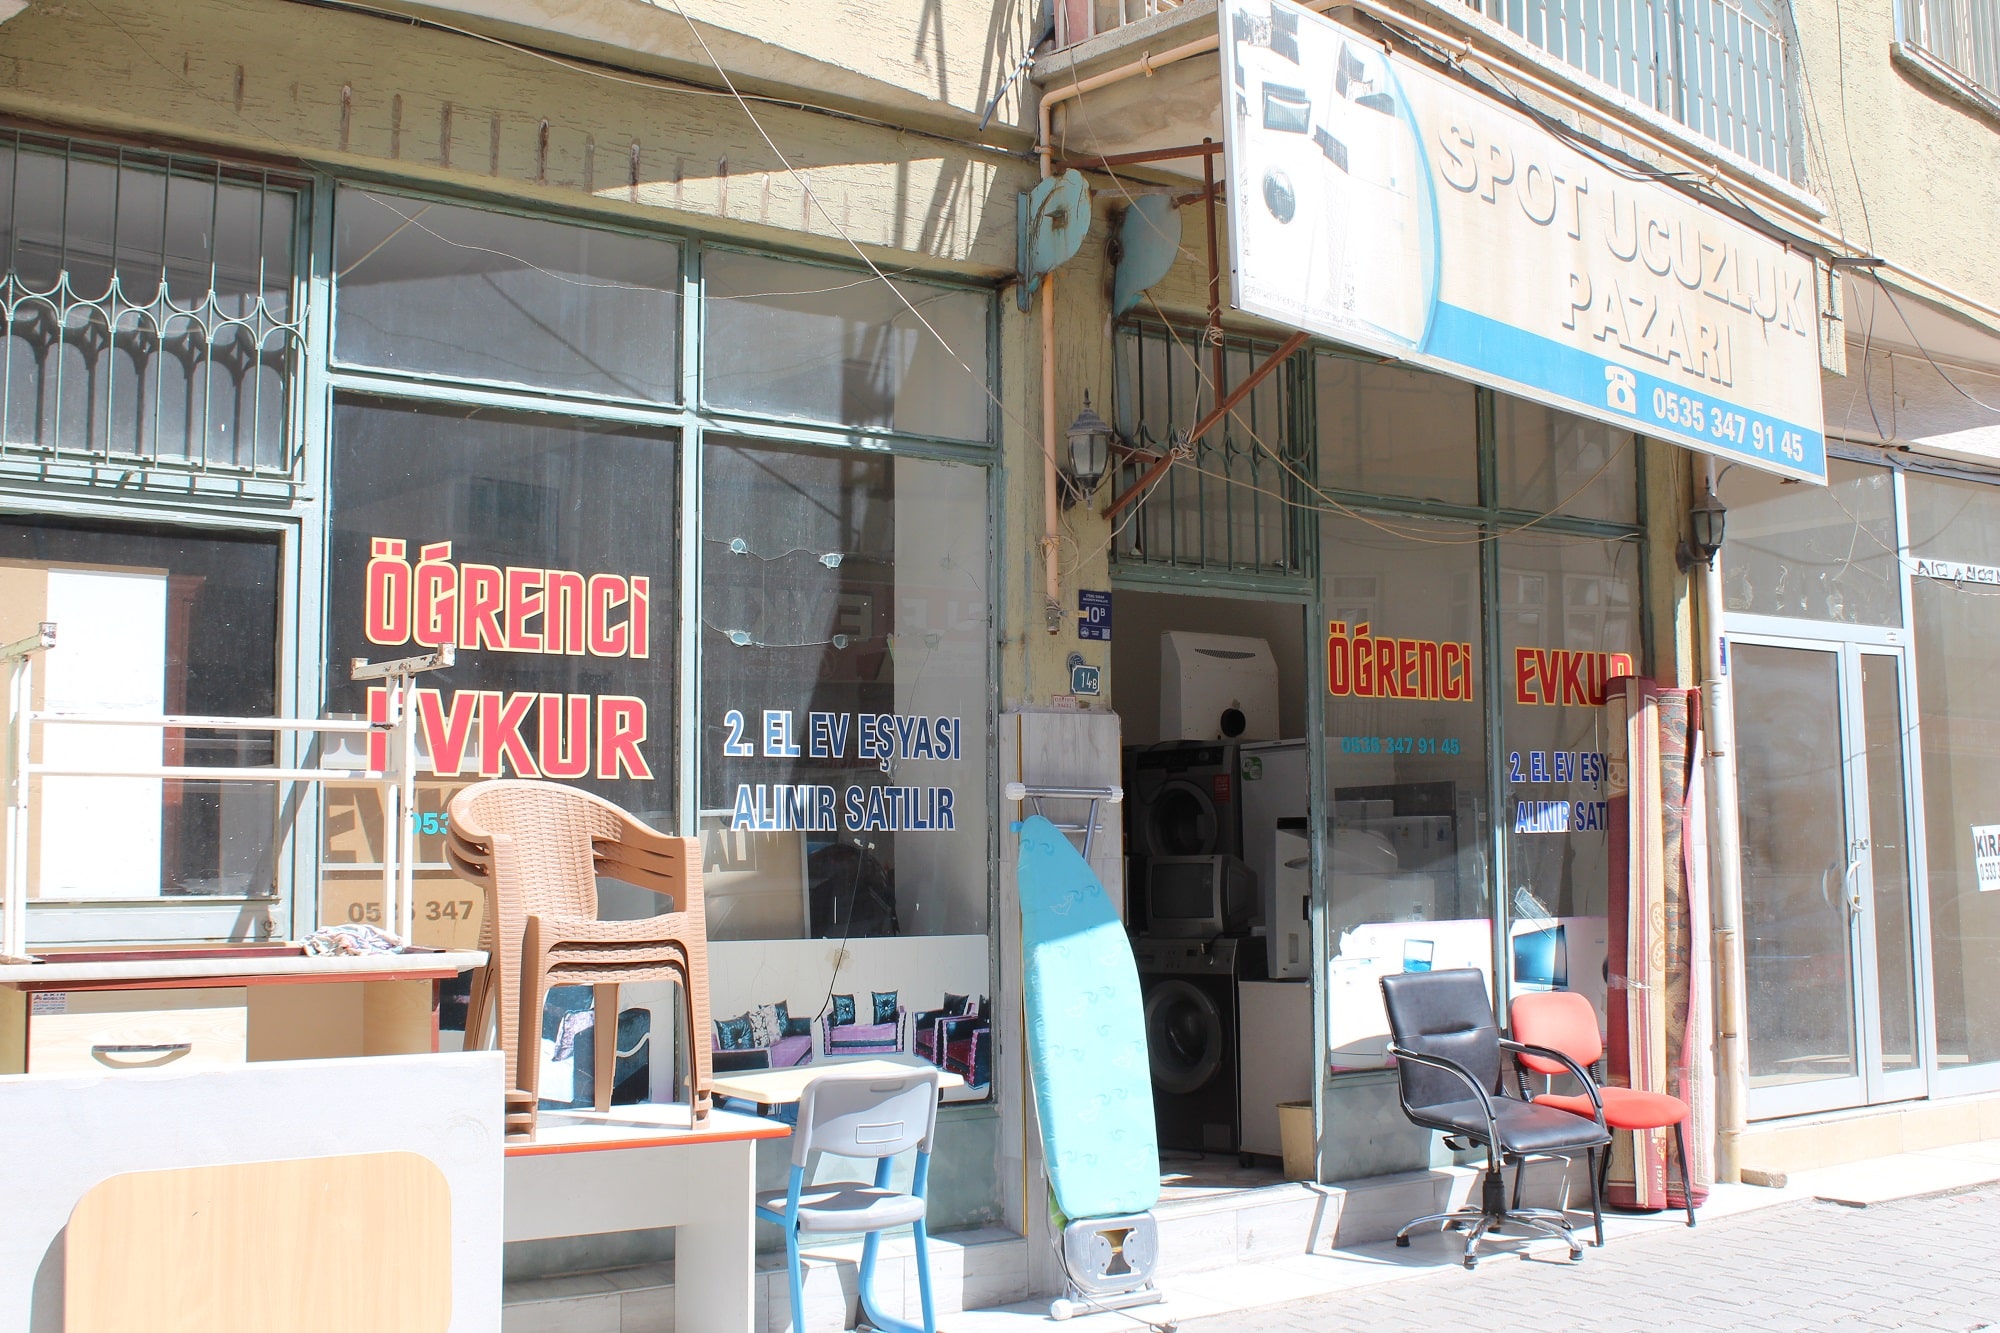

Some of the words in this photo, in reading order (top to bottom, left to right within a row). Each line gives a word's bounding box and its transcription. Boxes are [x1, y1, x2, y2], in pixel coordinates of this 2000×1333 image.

[1434, 119, 1588, 241] SPOT
[1604, 186, 1806, 338] UCUZLUK
[1560, 268, 1733, 389] PAZARI
[1653, 387, 1705, 432] 0535
[1710, 407, 1747, 445] 347
[1752, 420, 1774, 454] 91
[1781, 430, 1805, 463] 45
[723, 709, 754, 757] 2.
[763, 709, 800, 758] EL
[809, 711, 850, 759] EV
[858, 713, 961, 773] EŞYASI
[1341, 736, 1381, 754] 0535
[1385, 737, 1414, 754] 347
[1418, 738, 1436, 755] 91
[1441, 738, 1461, 755] 45
[1509, 752, 1526, 783] 2.
[1530, 751, 1550, 783] EL
[1554, 751, 1576, 783] EV
[730, 783, 838, 832] ALINIR
[844, 785, 956, 832] SATILIR
[1515, 800, 1571, 834] ALINIR
[1976, 829, 2000, 858] KİR
